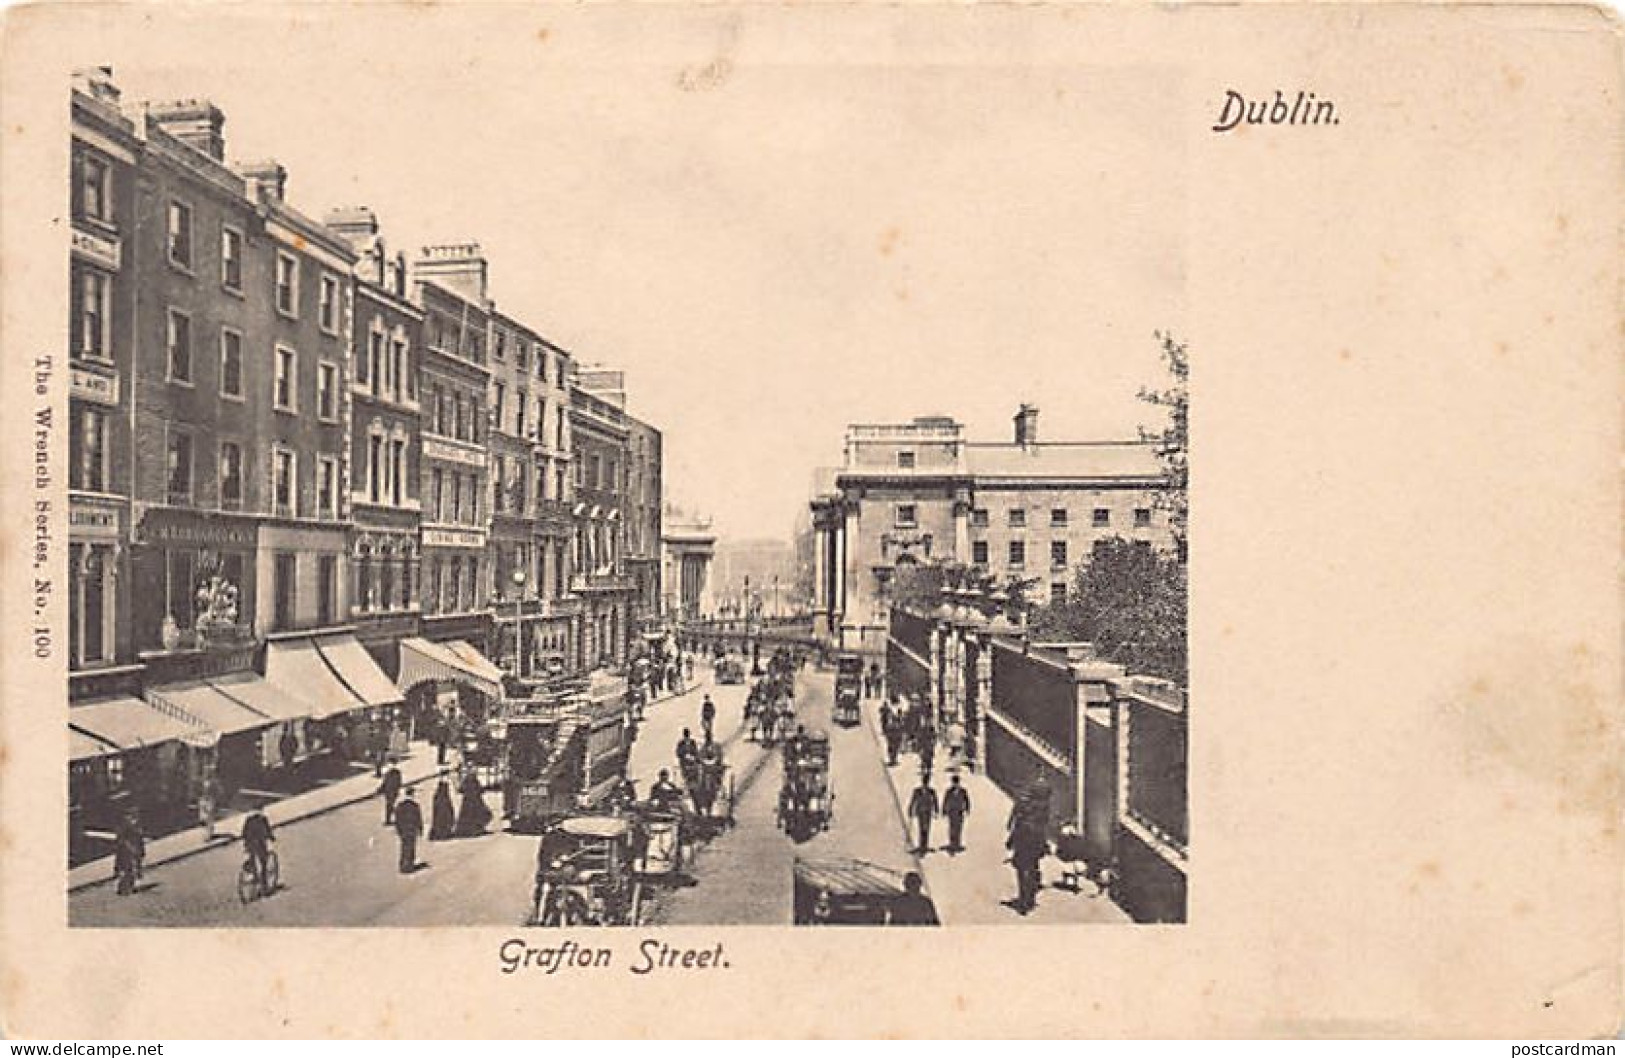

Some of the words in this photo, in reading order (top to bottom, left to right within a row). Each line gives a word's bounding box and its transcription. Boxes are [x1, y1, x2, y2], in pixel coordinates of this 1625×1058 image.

[1213, 90, 1339, 132] Dublin.
[37, 356, 52, 395] The
[37, 407, 51, 488] Wrench
[35, 501, 51, 568] Series,
[35, 579, 51, 615] No.
[35, 628, 51, 657] 100
[500, 939, 611, 974] Grafton
[630, 939, 729, 974] Street.
